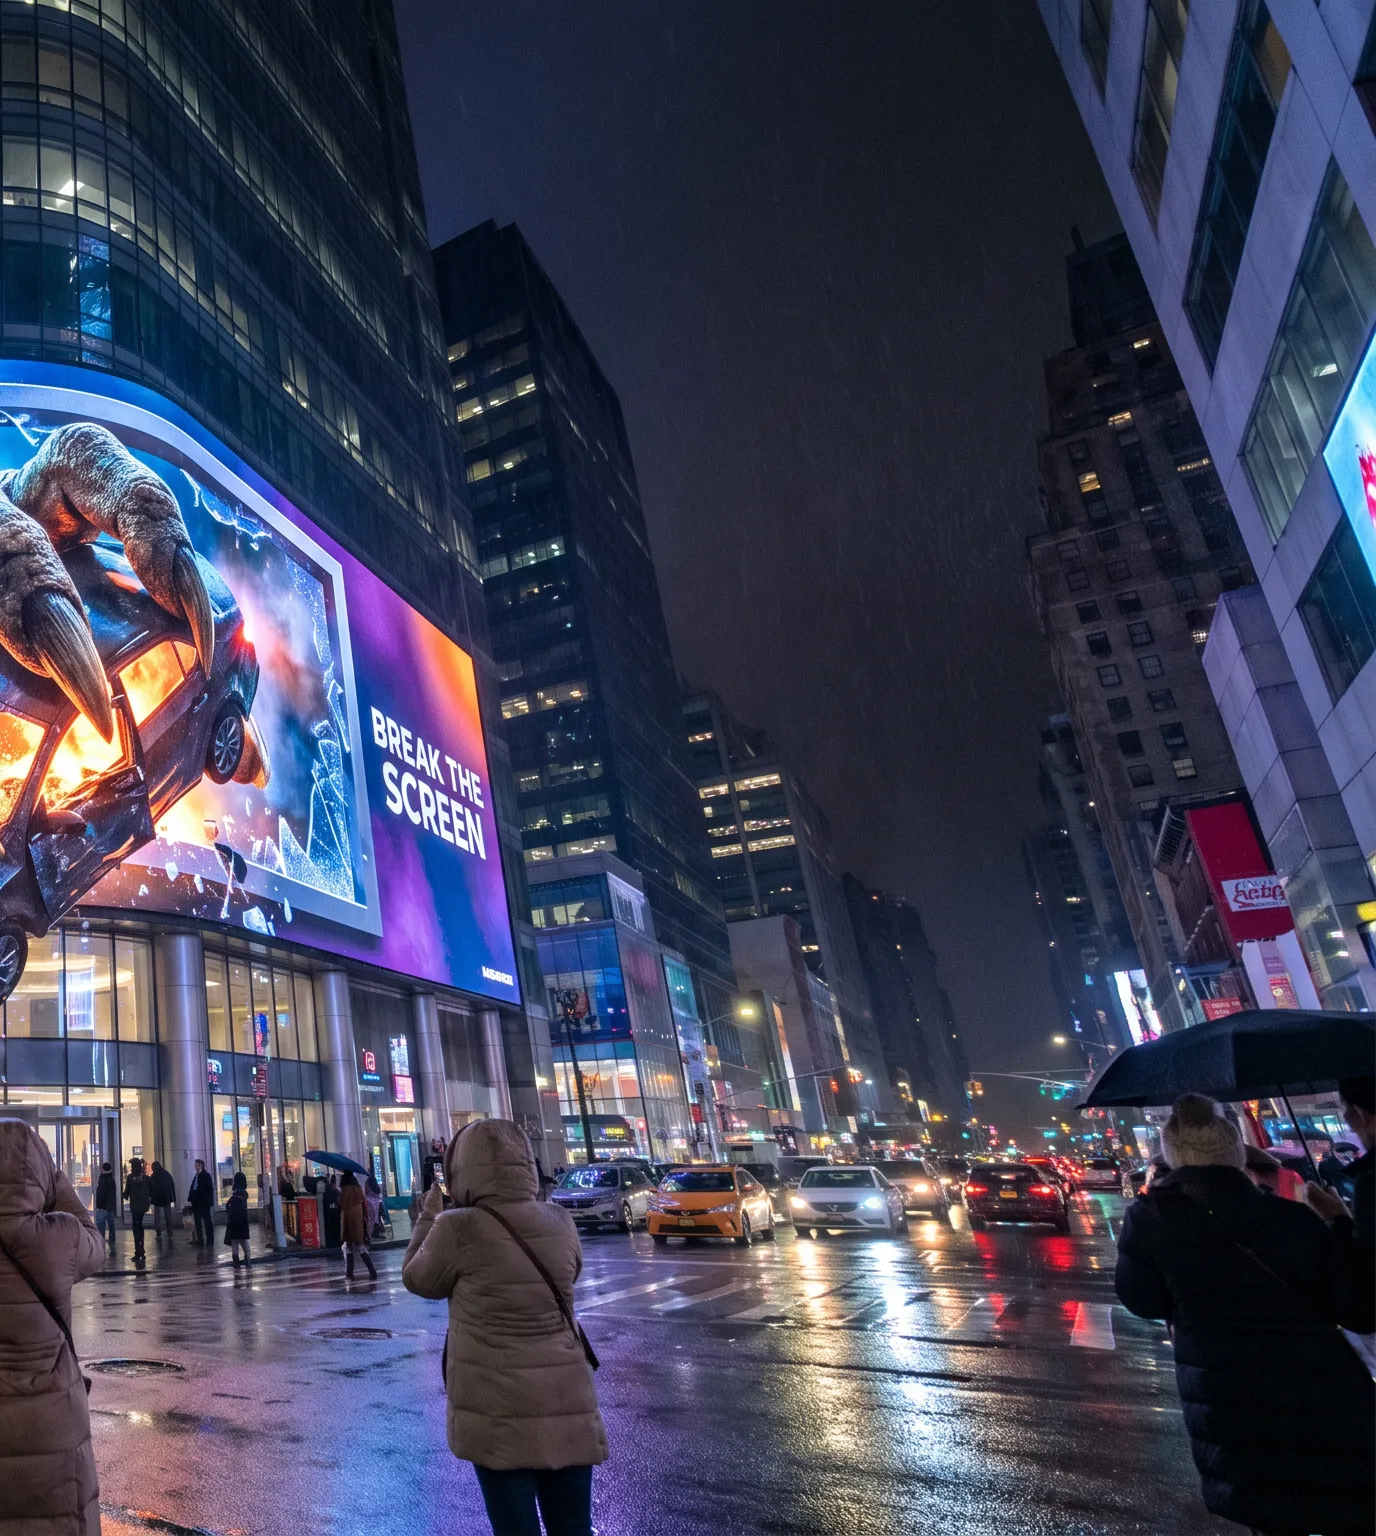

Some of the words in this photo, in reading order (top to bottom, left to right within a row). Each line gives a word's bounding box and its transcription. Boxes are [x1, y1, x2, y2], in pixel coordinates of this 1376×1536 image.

[370, 706, 446, 786] BREAK
[444, 754, 485, 809] THE
[382, 761, 487, 861] SCREEN
